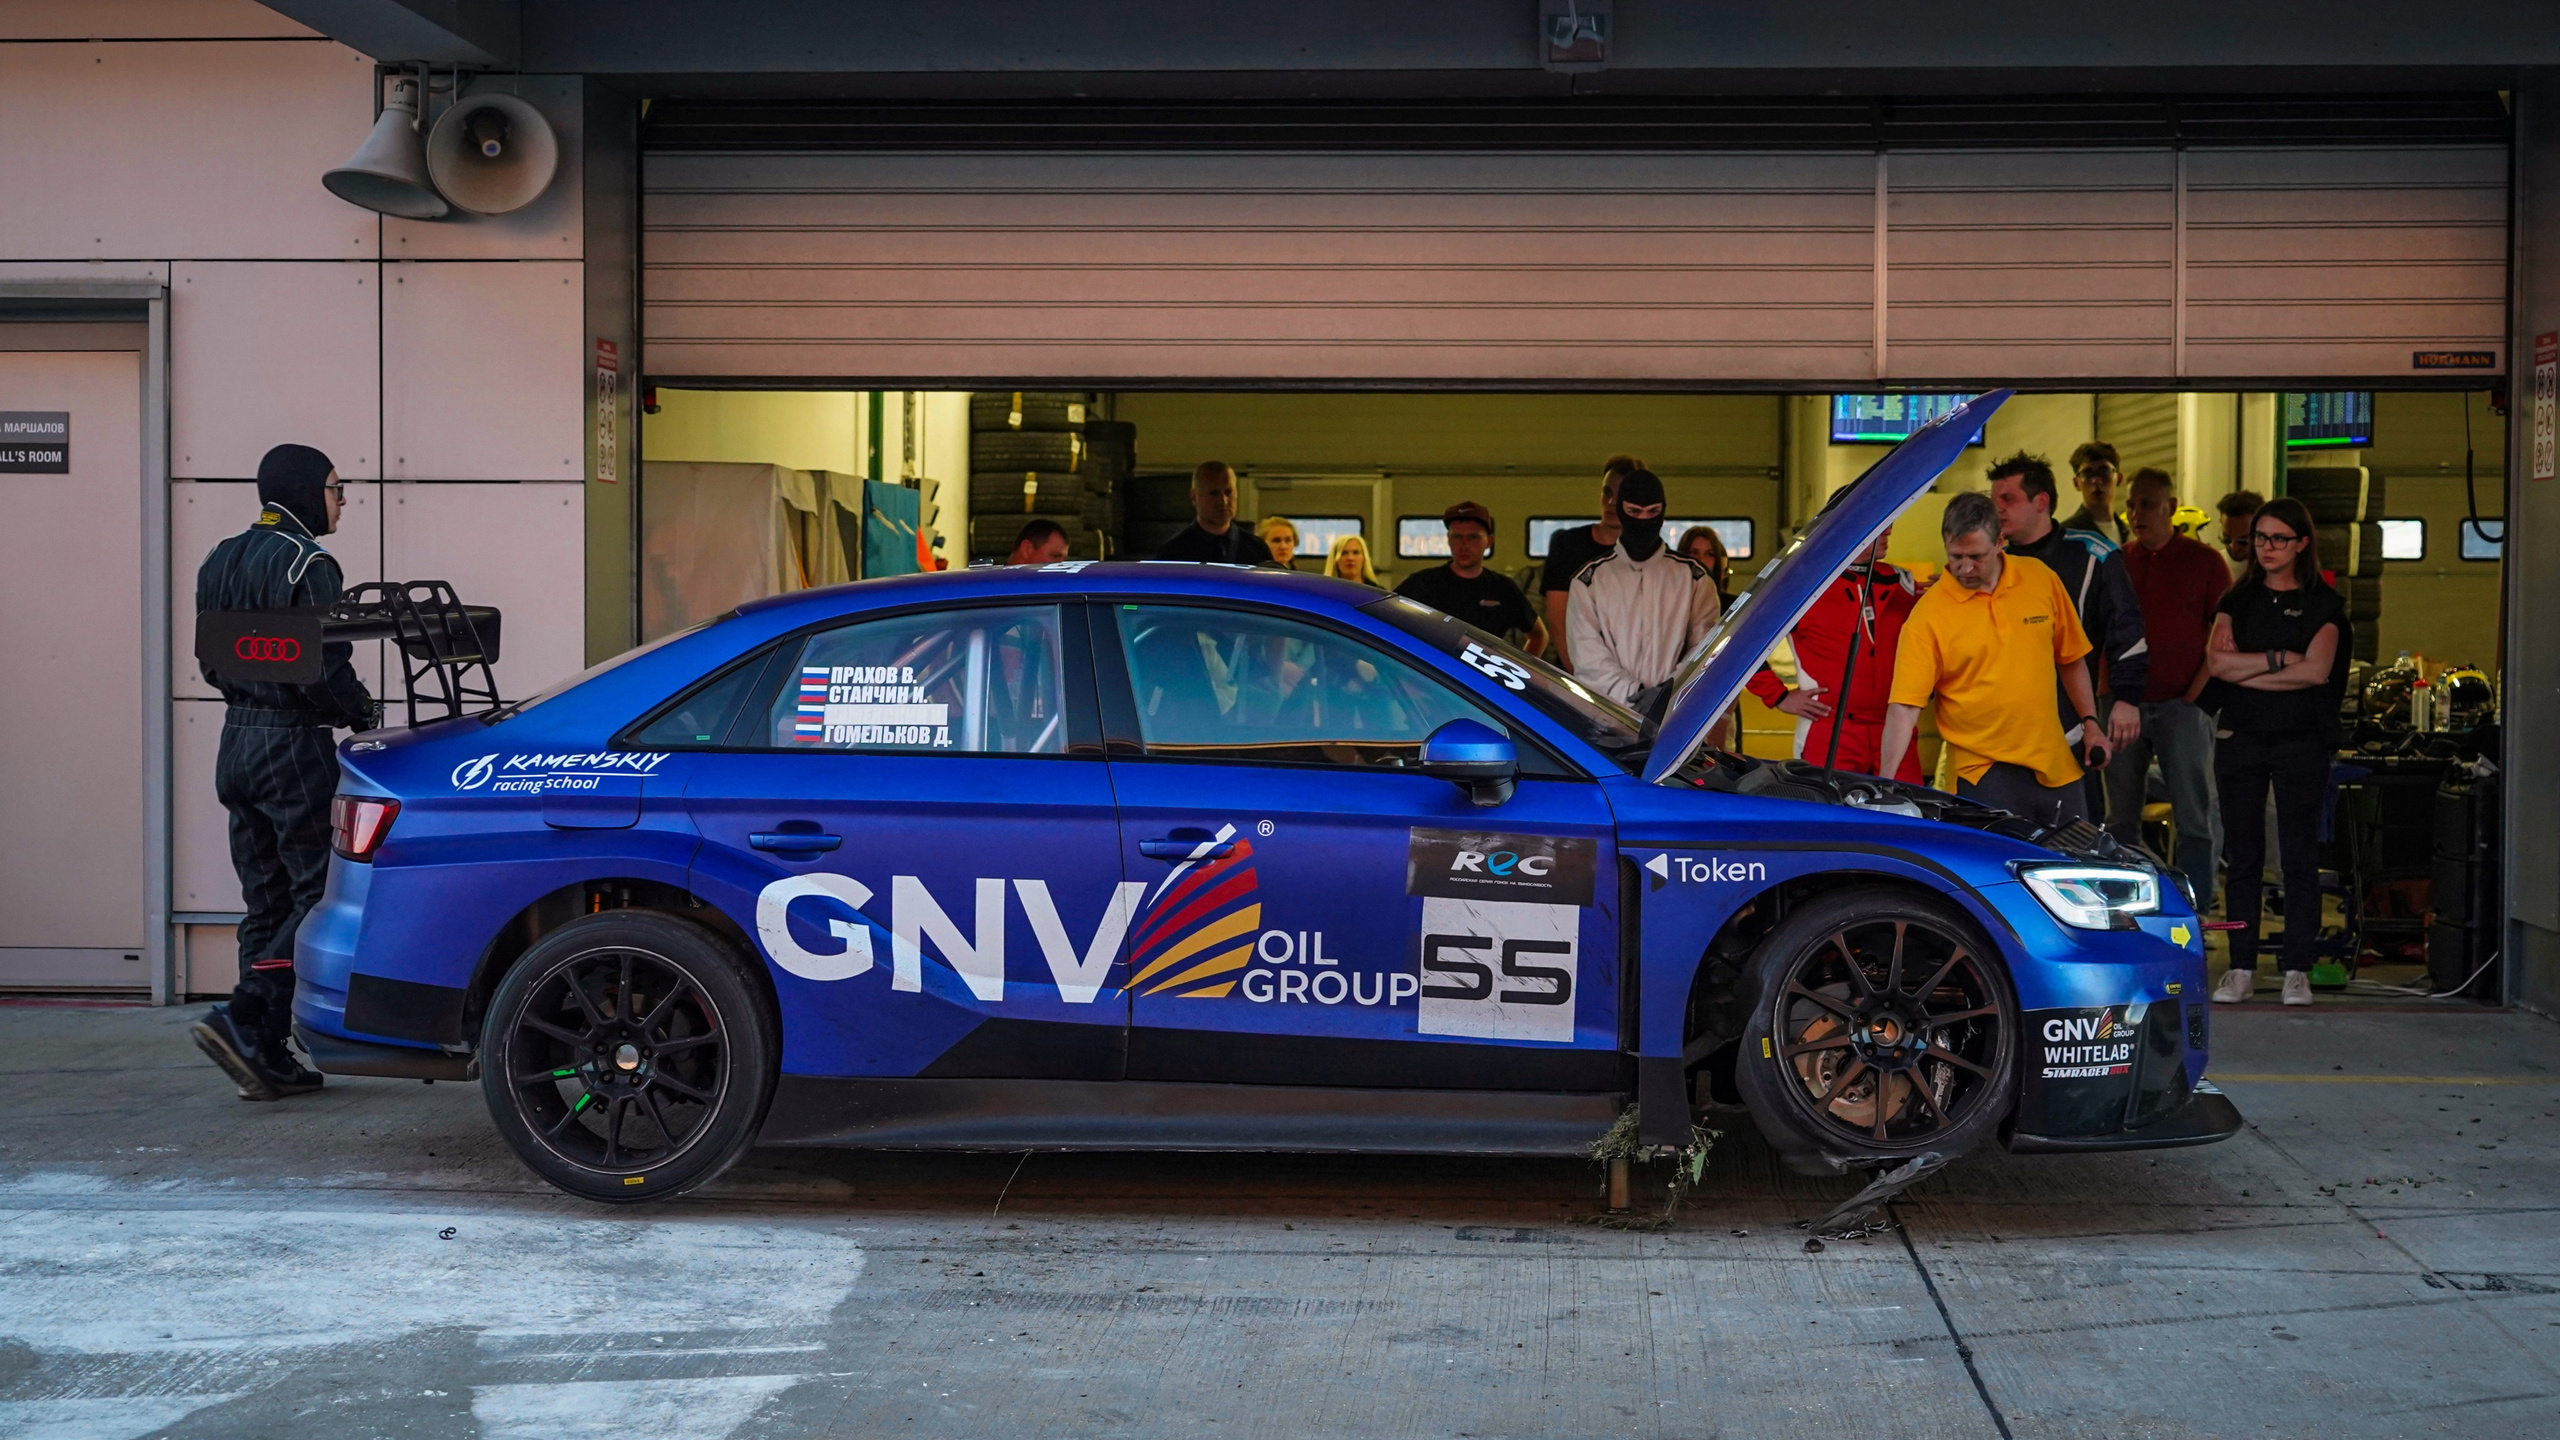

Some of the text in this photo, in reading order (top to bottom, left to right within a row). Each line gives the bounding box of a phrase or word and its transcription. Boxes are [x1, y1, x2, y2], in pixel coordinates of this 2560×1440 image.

[4, 423, 64, 433] МАРШАЛОВ
[29, 451, 62, 462] ROOM
[830, 666, 917, 684] ПРАХОВ В.
[1460, 642, 1531, 690] 55
[829, 685, 927, 703] СТАНЧИН И.
[824, 725, 953, 748] ГОМЕЛЬКОВ Д.
[503, 751, 670, 772] KAMENSKIY
[492, 776, 600, 794] racing school
[1674, 857, 1766, 882] Token
[755, 872, 1148, 1003] GNV
[1257, 930, 1339, 965] OIL
[1421, 933, 1572, 1006] 55
[1242, 969, 1418, 1006] GROUP
[2043, 1017, 2100, 1042] GNV
[2113, 1030, 2134, 1038] GROUP
